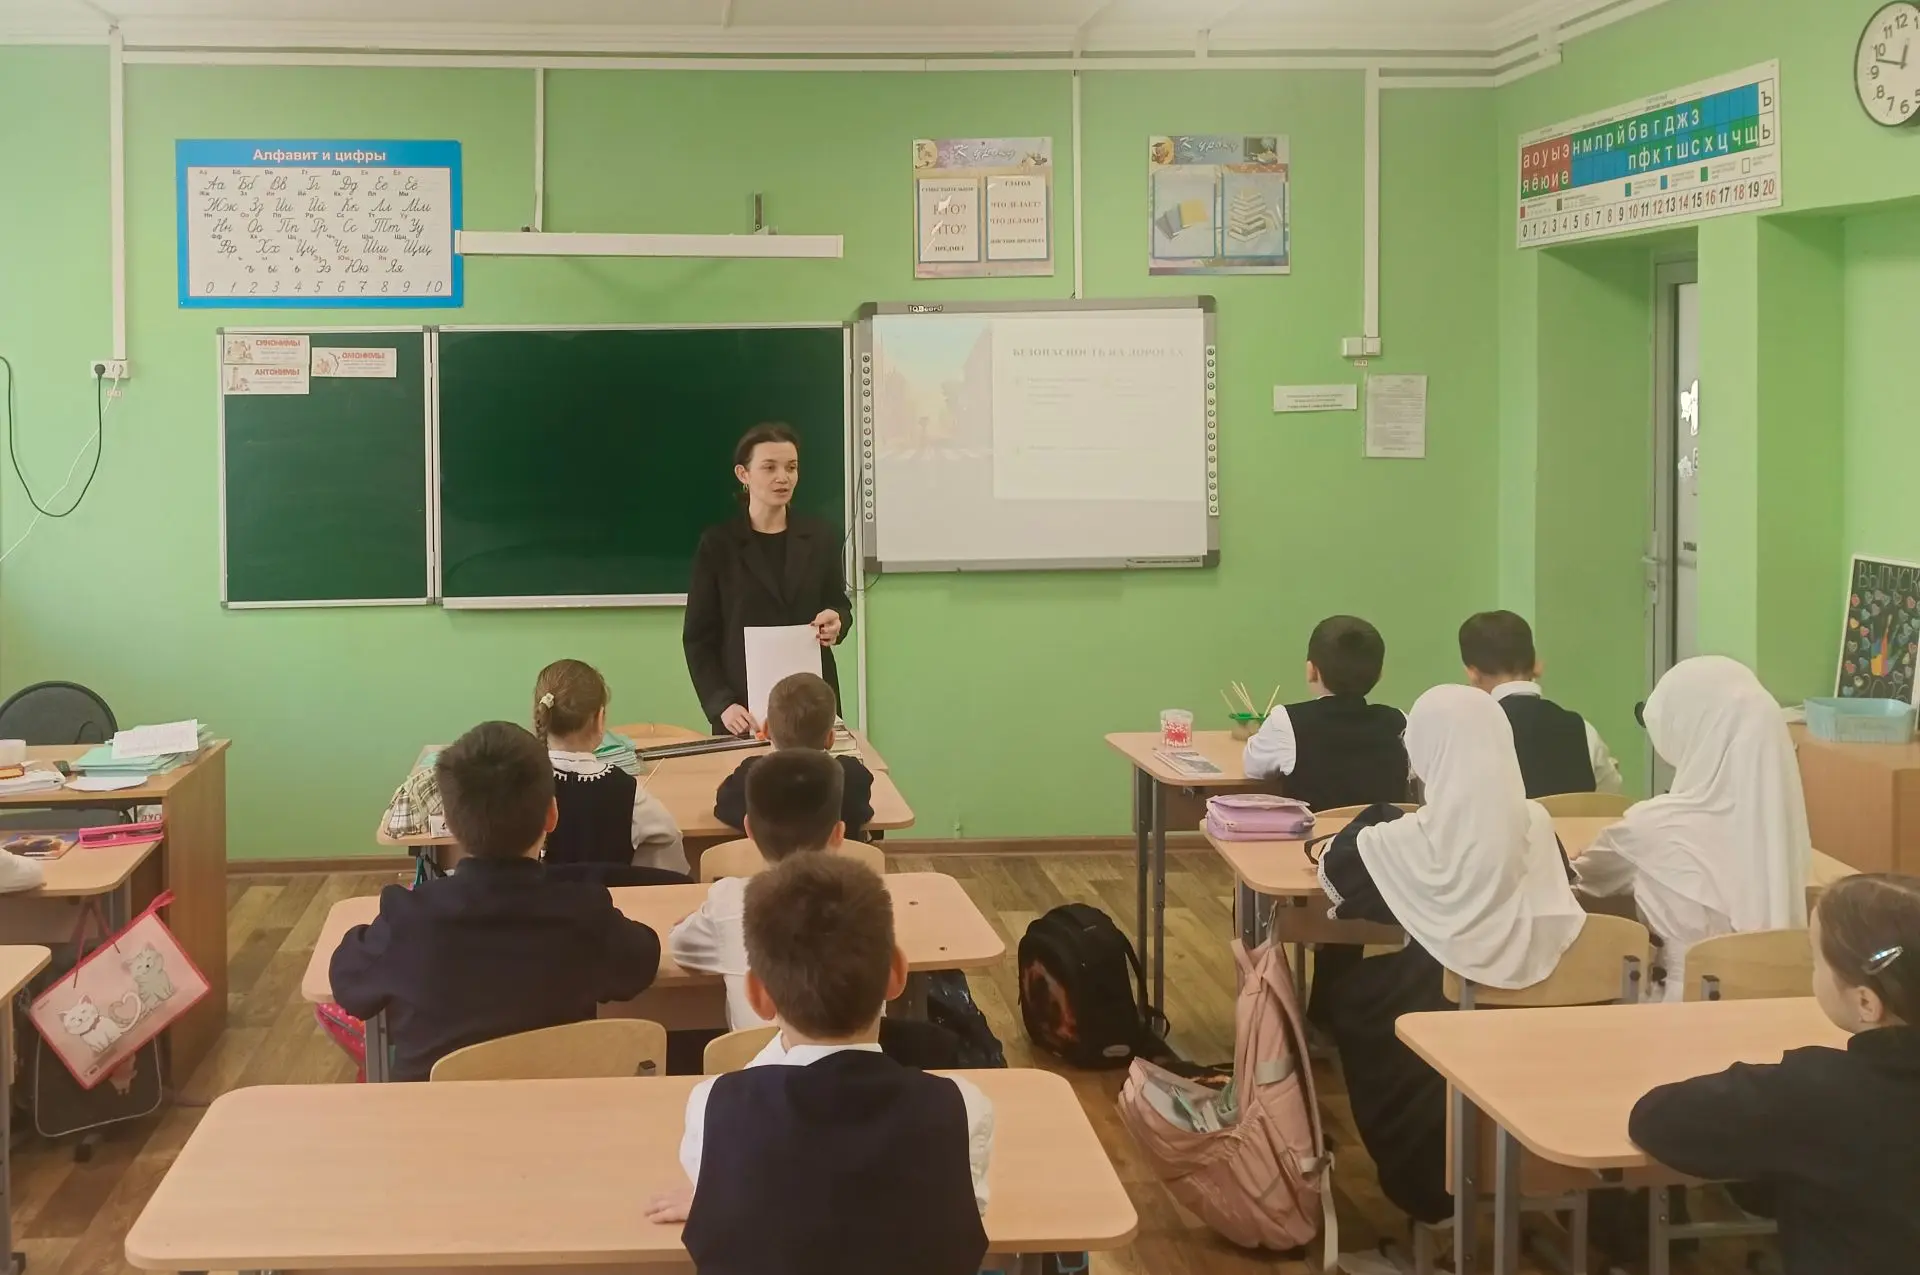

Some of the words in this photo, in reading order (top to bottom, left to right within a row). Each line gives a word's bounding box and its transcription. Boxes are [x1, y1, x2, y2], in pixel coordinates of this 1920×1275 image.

[1894, 13, 1908, 29] 12
[1914, 15, 1919, 30] 1
[1884, 24, 1893, 39] 11
[1873, 42, 1886, 58] 10
[1870, 65, 1880, 80] 9
[1876, 84, 1885, 100] 8
[1887, 96, 1895, 111] 7
[1900, 99, 1910, 114] 6
[253, 149, 318, 163] Алфавит
[322, 152, 331, 160] и
[335, 149, 386, 163] цифры
[1523, 225, 1527, 238] 0
[1533, 223, 1537, 236] 1
[1542, 221, 1546, 234] 2
[1552, 219, 1557, 232] 3
[1562, 217, 1567, 230] 4
[1574, 215, 1578, 228] 5
[1584, 213, 1590, 226] 6
[1596, 210, 1601, 225] 7
[1607, 208, 1612, 223] 8
[1619, 207, 1624, 221] 9
[1629, 204, 1638, 219] 10
[1641, 201, 1649, 216] 11
[1654, 199, 1662, 215] 12
[1666, 197, 1676, 212] 13
[1679, 194, 1688, 211] 14
[1692, 191, 1702, 208] 15
[1706, 189, 1716, 205] 16
[1719, 187, 1730, 203] 17
[1734, 184, 1744, 200] 18
[1748, 181, 1760, 198] 19
[1763, 179, 1775, 196] 20
[206, 282, 214, 293] 0
[230, 282, 236, 293] 1
[250, 282, 258, 293] 2
[272, 281, 280, 293] 3
[294, 281, 302, 293] 4
[314, 281, 324, 293] 5
[337, 281, 345, 292] 6
[360, 281, 368, 292] 7
[381, 281, 389, 292] 8
[403, 281, 410, 292] 9
[426, 281, 443, 293] 10
